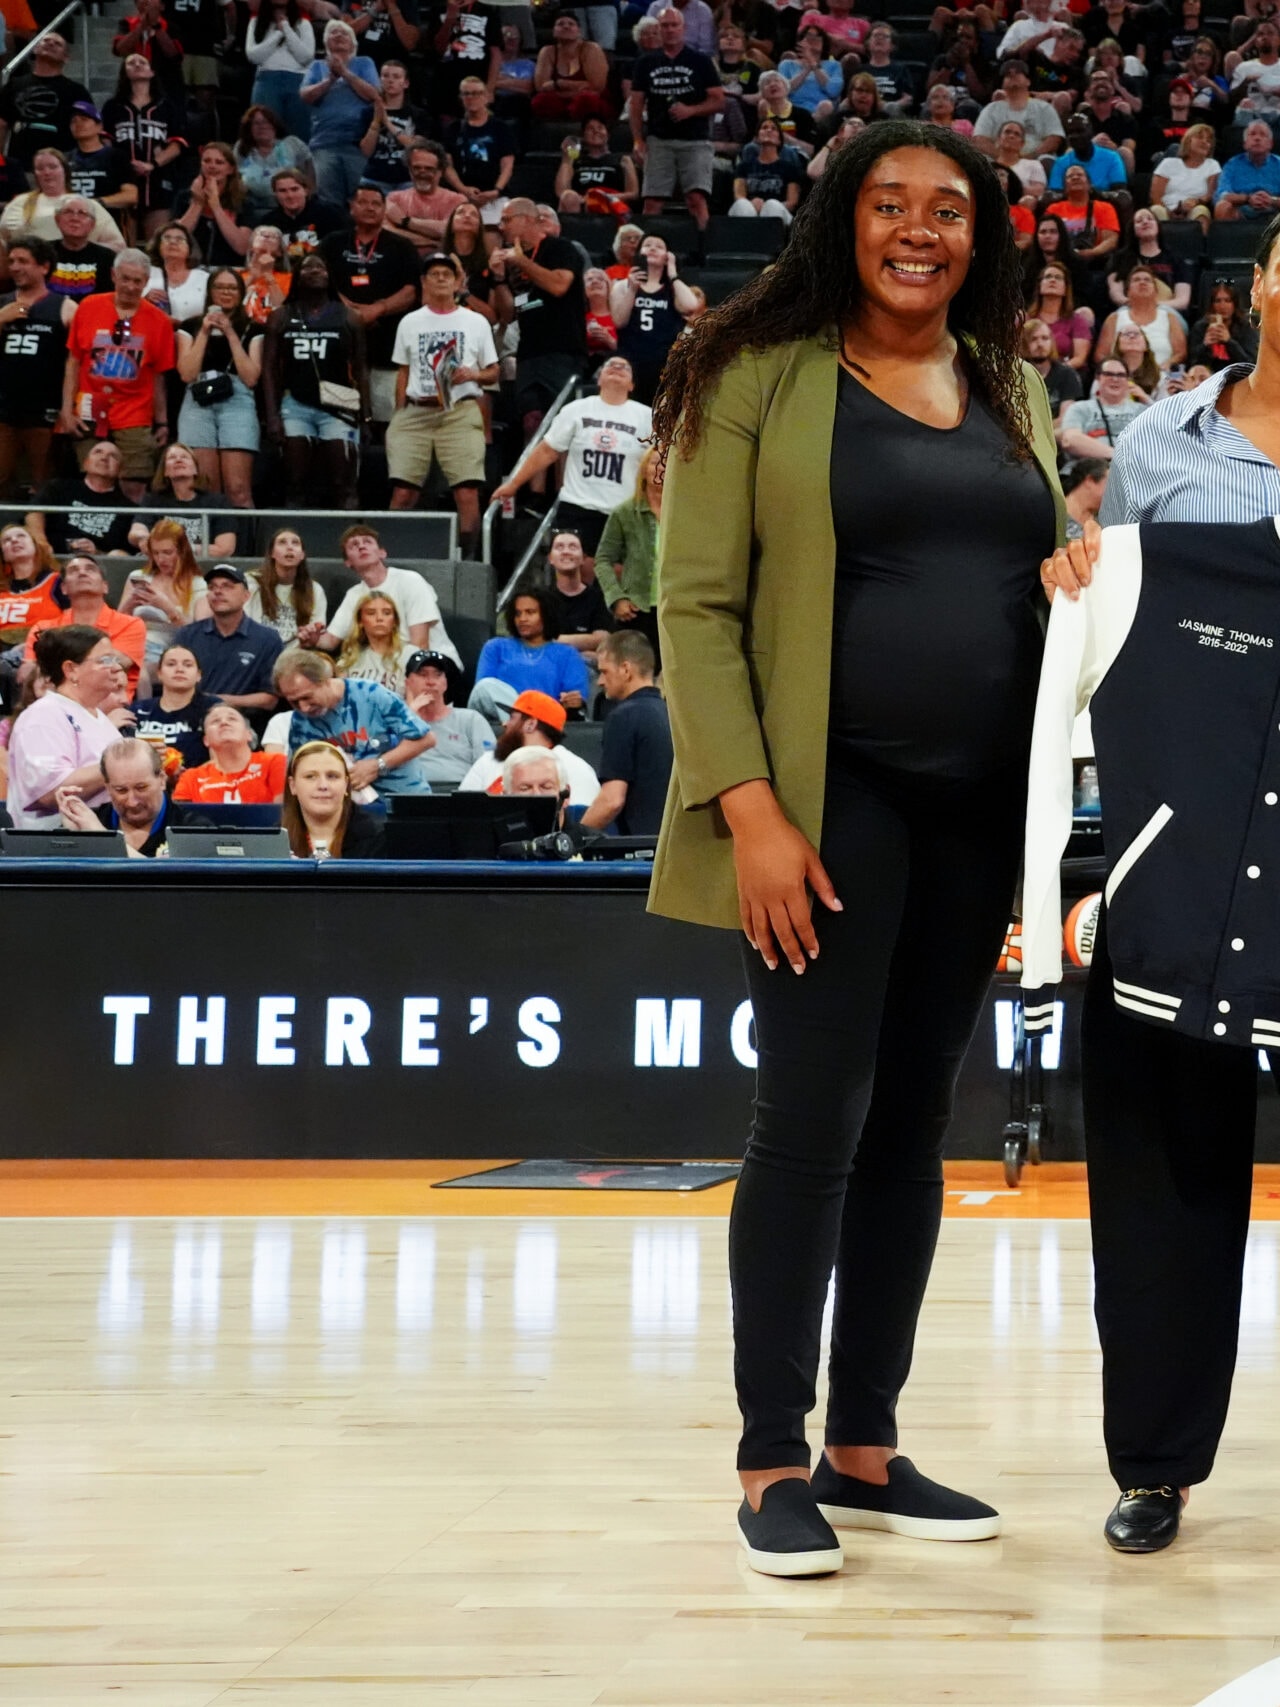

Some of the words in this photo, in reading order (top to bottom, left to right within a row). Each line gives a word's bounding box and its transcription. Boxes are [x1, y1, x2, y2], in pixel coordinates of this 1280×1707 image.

[640, 310, 654, 331] 5
[4, 334, 39, 355] 25
[293, 338, 327, 360] 24
[582, 449, 626, 484] SUN
[1178, 619, 1224, 637] JASMINE
[1229, 630, 1274, 648] THOMAS
[1198, 635, 1248, 654] 2015-2022
[140, 720, 192, 735] UCON
[102, 995, 562, 1068] THERE'S
